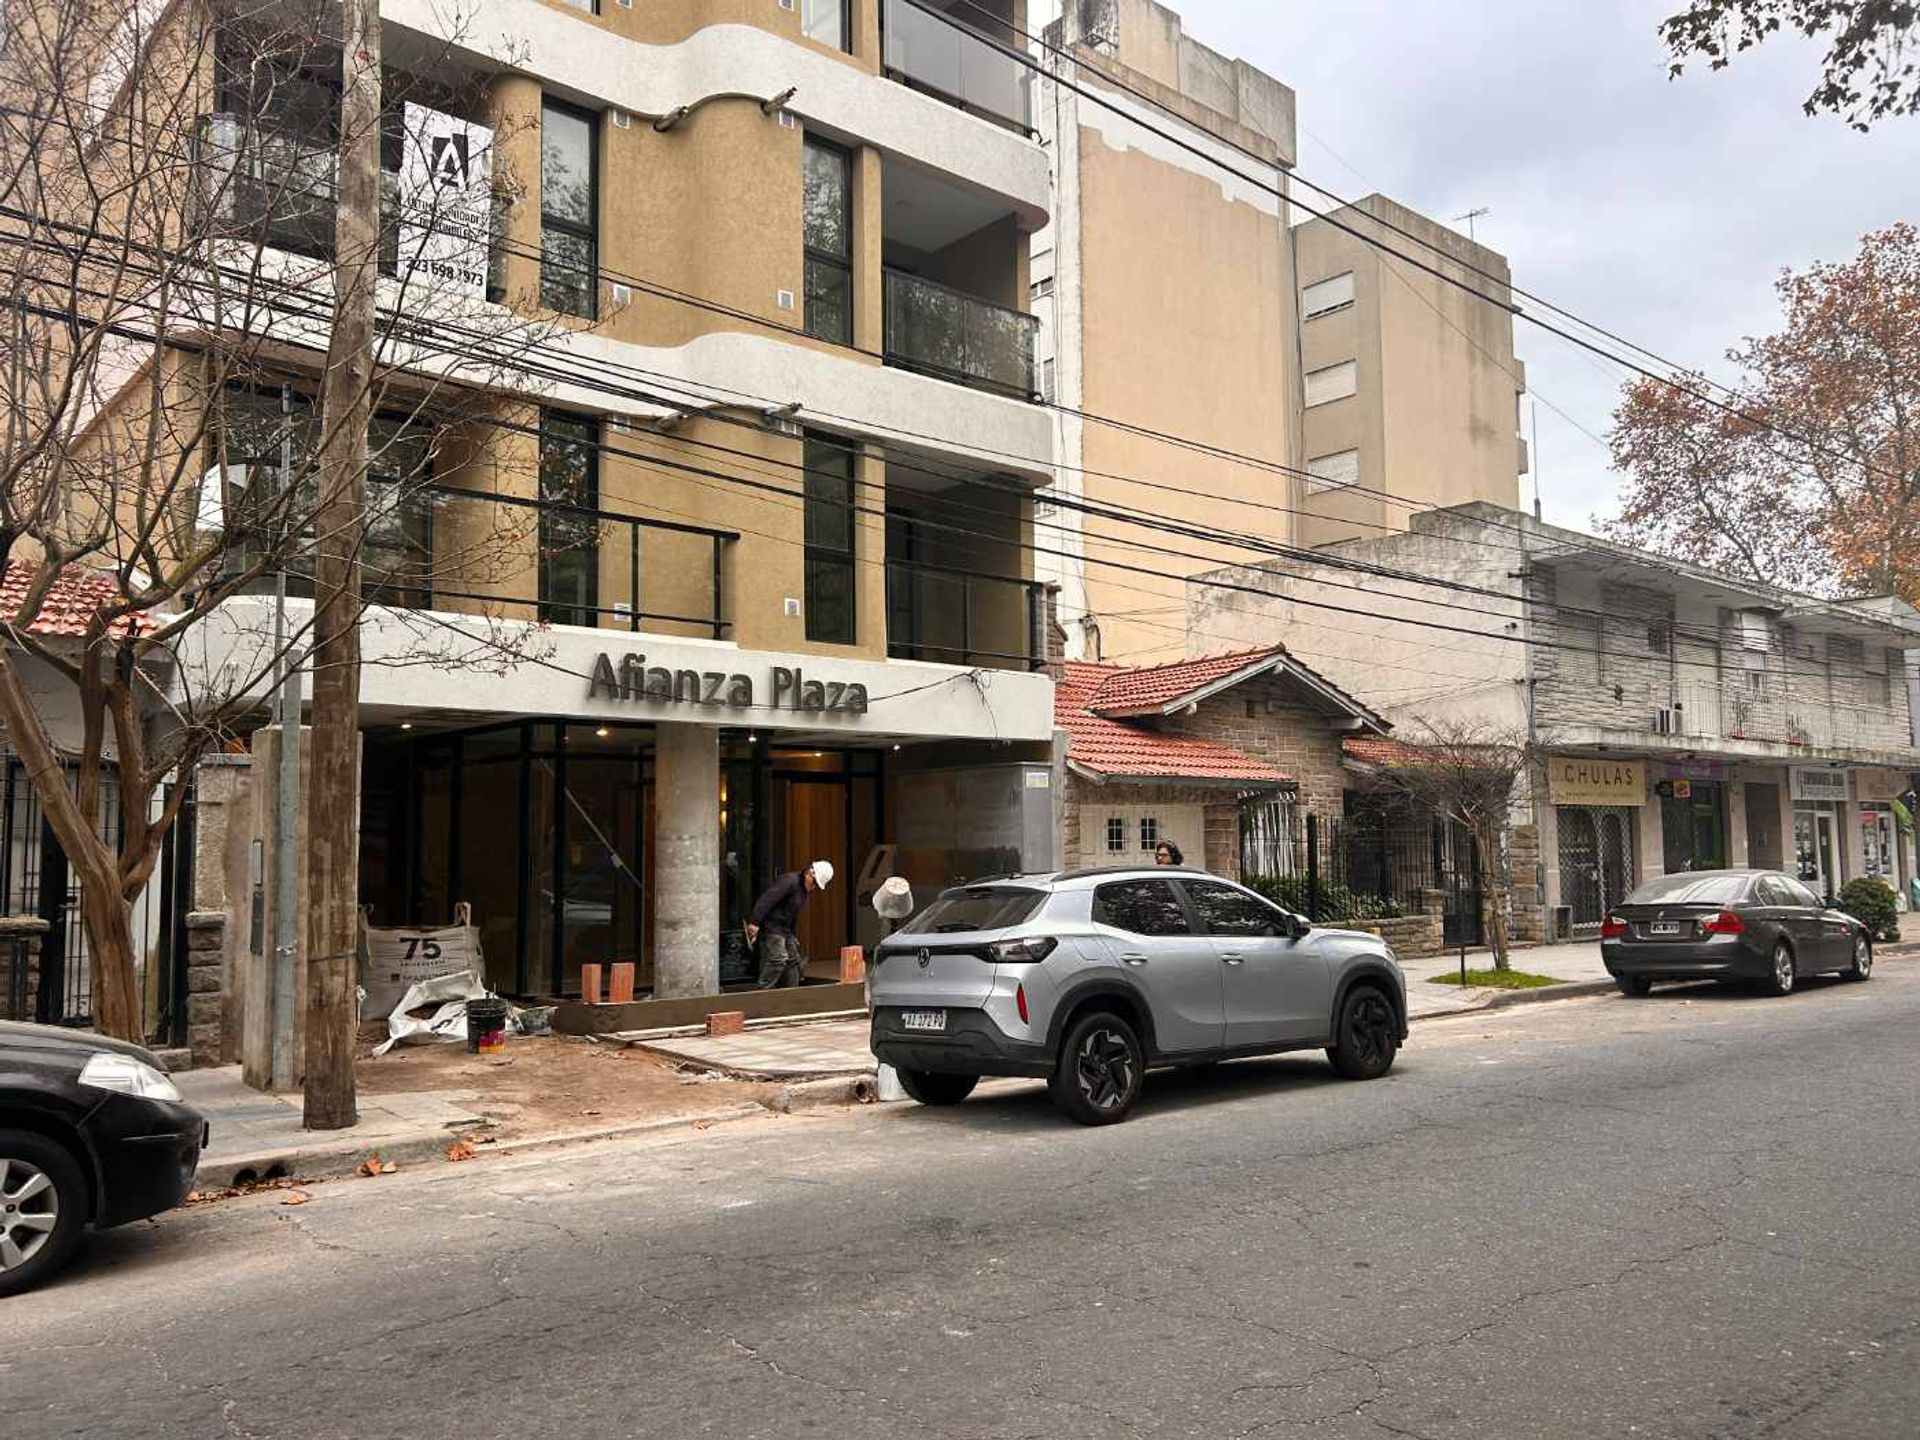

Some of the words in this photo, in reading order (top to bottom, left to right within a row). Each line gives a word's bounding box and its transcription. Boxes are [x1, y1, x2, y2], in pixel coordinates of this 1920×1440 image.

[431, 262, 454, 280] 698
[588, 652, 753, 707] Afianza
[769, 665, 869, 714] Plaza
[1565, 764, 1634, 785] CHULAS
[399, 937, 442, 960] 75
